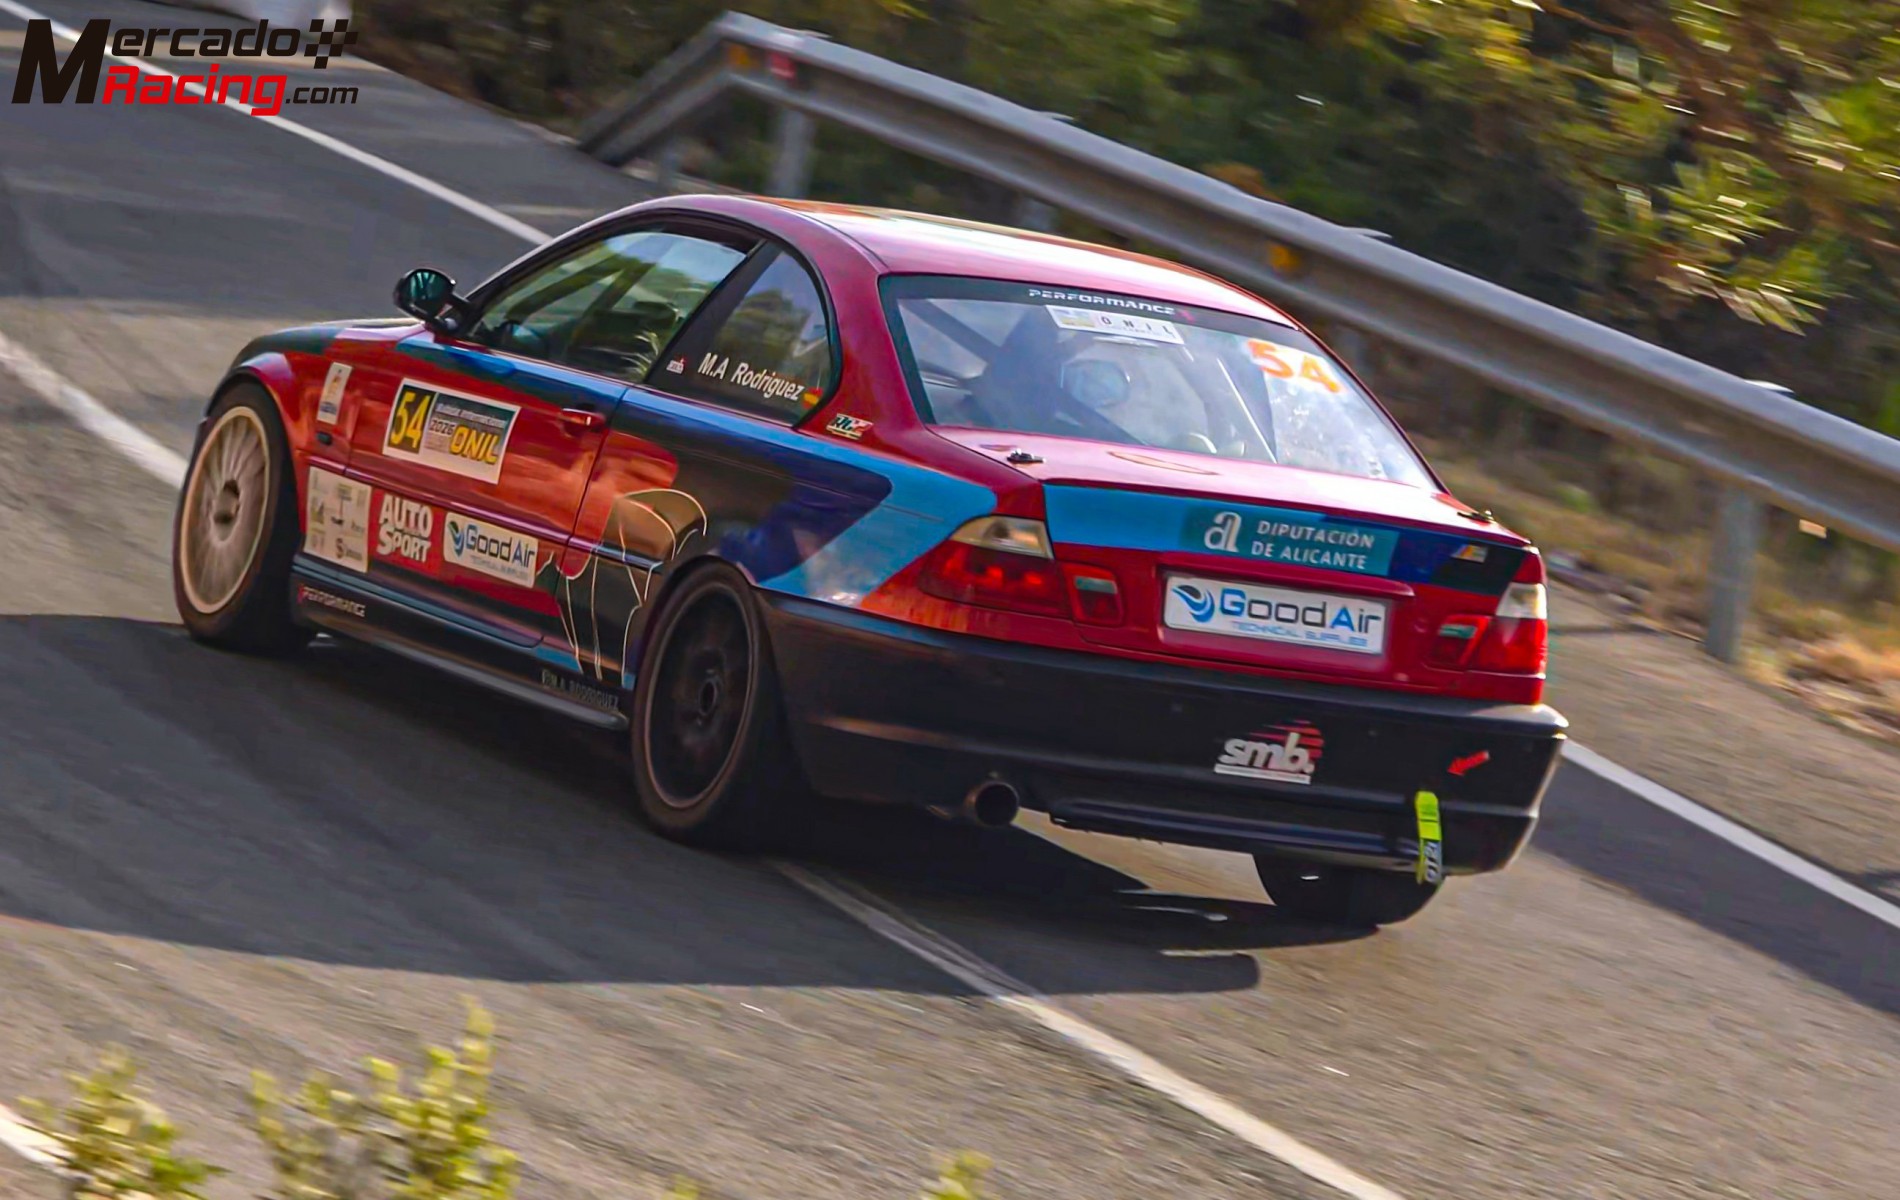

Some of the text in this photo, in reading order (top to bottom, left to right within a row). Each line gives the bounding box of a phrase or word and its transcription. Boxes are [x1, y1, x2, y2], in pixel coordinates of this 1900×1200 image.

[1028, 288, 1176, 316] PERFORMANCE
[697, 352, 730, 380] M.A
[730, 362, 805, 401] Rodriguez
[391, 391, 431, 449] 54
[449, 423, 500, 464] ONIL
[379, 493, 433, 538] AUTO
[1257, 520, 1375, 549] DIPUTACIÓN
[376, 523, 431, 563] SPORT
[465, 524, 535, 568] GoodAir
[1251, 541, 1368, 570] DE ALICANTE
[1220, 588, 1382, 634] GoodAir
